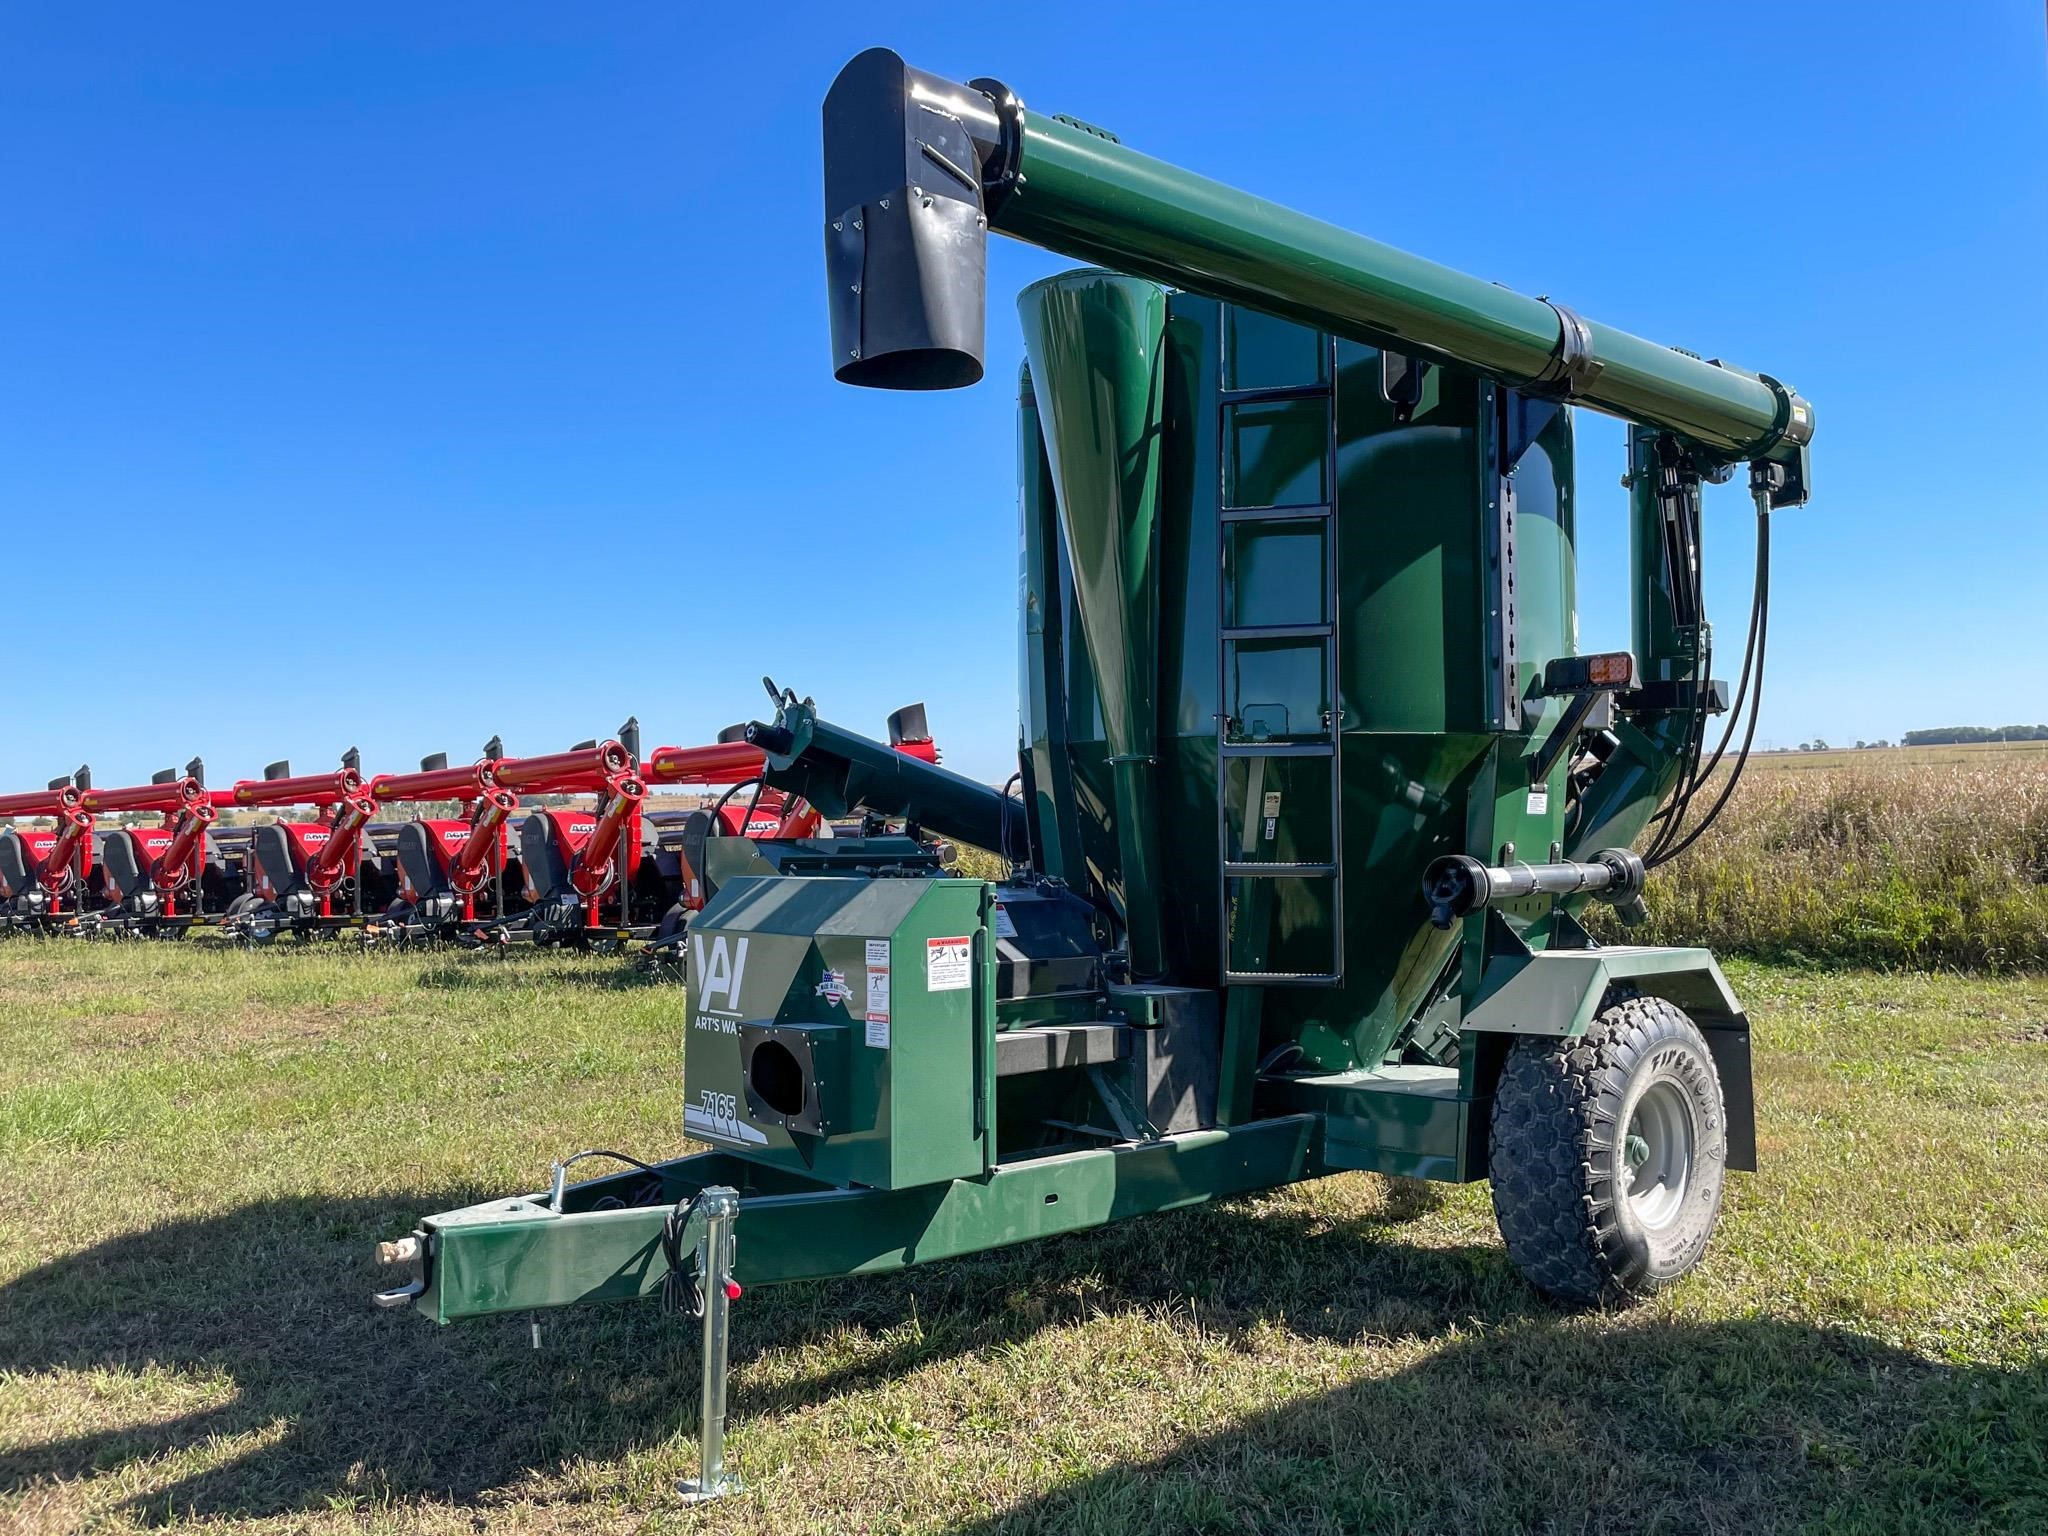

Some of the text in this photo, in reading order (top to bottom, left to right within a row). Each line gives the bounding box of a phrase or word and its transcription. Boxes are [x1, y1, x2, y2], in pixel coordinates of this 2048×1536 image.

[694, 1015, 738, 1035] ART'S WA
[701, 1089, 737, 1121] 7165
